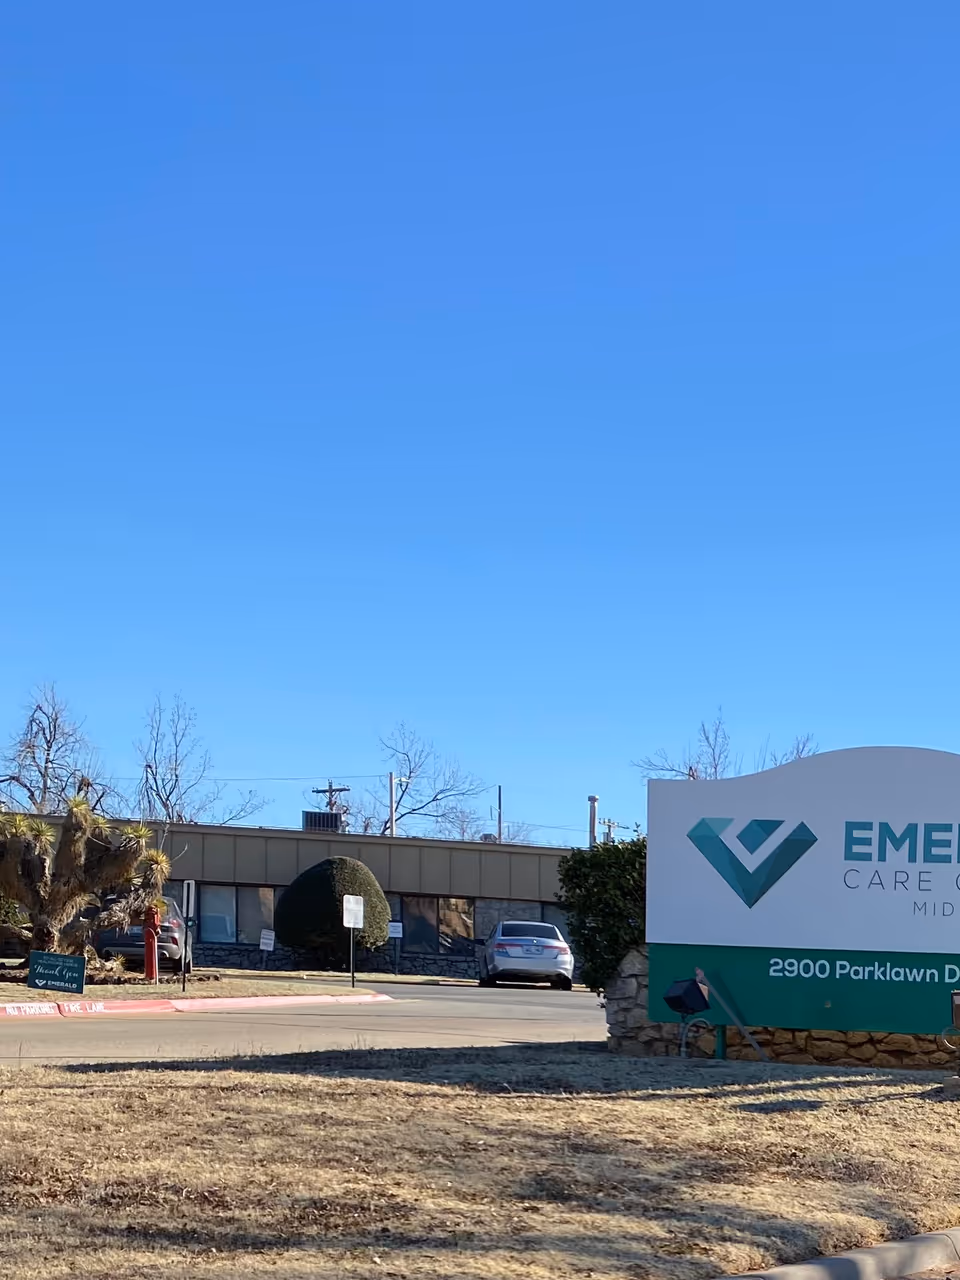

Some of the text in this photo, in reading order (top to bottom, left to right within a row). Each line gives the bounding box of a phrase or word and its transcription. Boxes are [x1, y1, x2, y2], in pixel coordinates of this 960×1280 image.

[843, 868, 932, 892] CARE
[769, 957, 830, 979] 2900
[835, 960, 938, 983] Parklawn
[47, 980, 77, 989] EMERALD
[63, 1002, 83, 1013] FIRE
